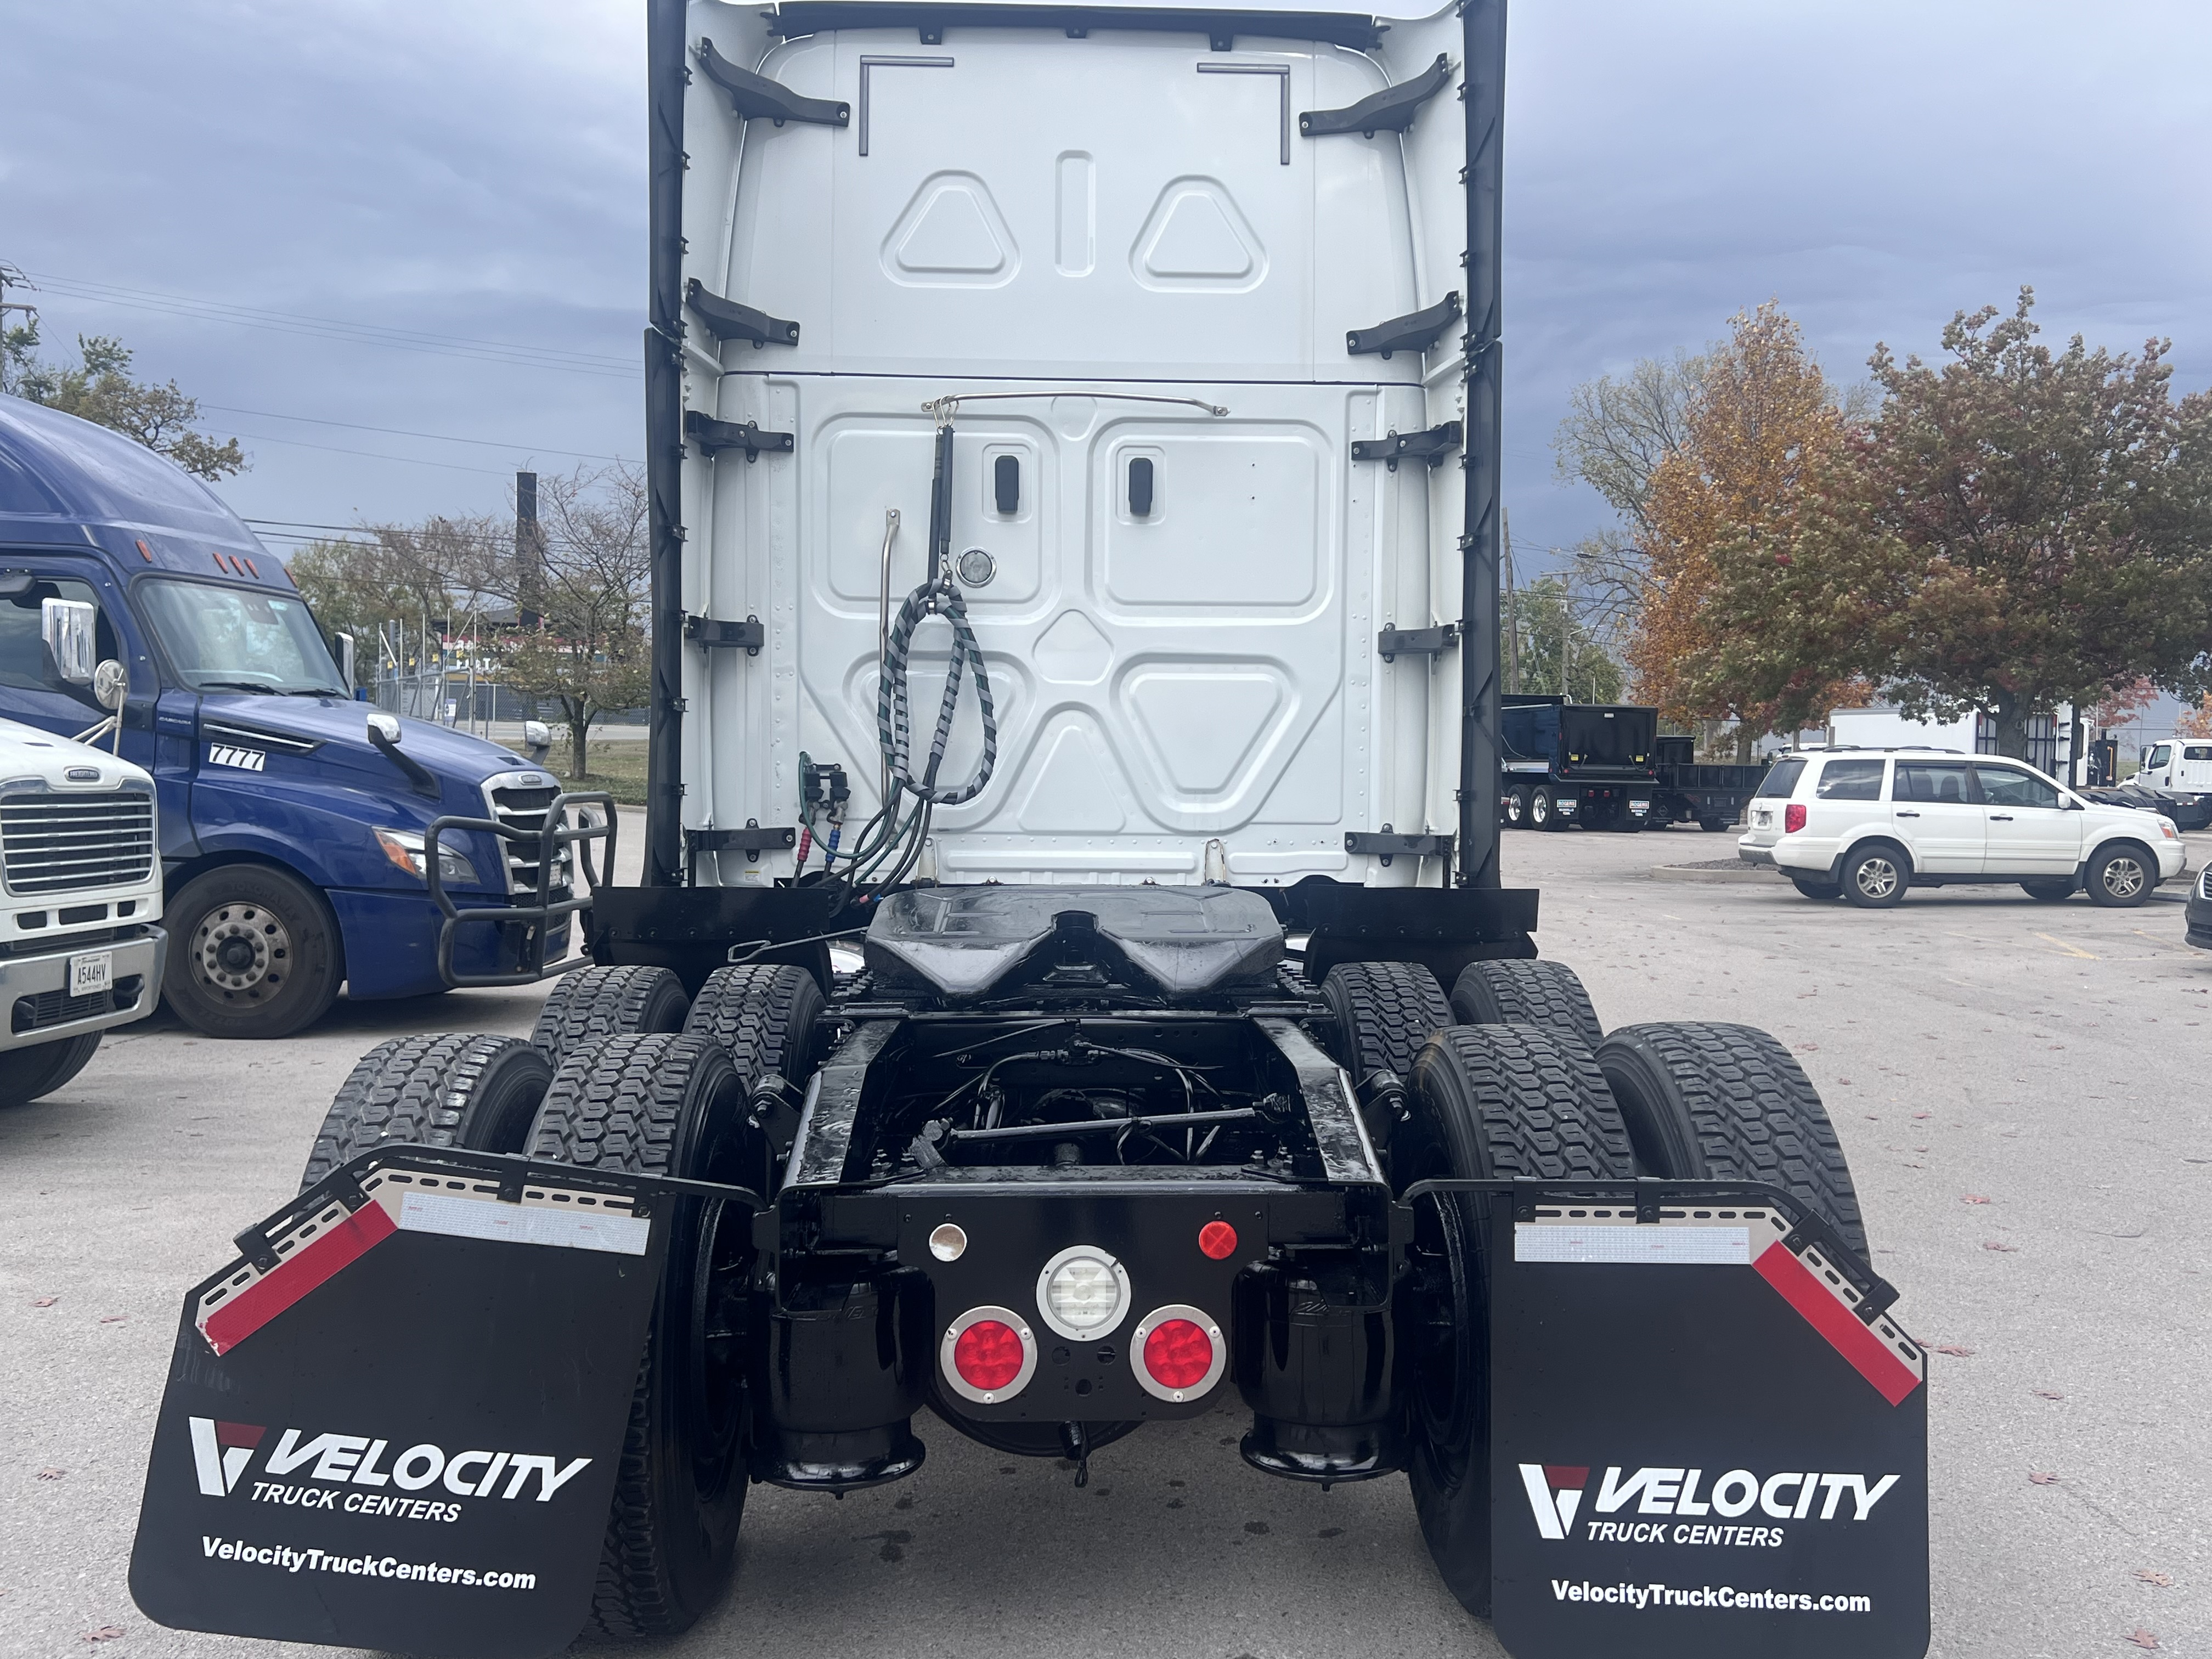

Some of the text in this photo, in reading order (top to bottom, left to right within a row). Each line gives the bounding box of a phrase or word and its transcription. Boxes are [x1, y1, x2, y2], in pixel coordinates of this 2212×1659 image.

[212, 744, 264, 769] 7777
[77, 963, 106, 985] A544HV
[265, 1429, 593, 1502] VELOCITY
[251, 1481, 462, 1522] TRUCK CENTERS
[1595, 1466, 1901, 1521] VELOCITY
[1587, 1521, 1784, 1547] TRUCK CENTERS
[202, 1536, 536, 1589] VelocityTruckCenters.com
[1551, 1579, 1871, 1612] VelocityTruckCenters.com
